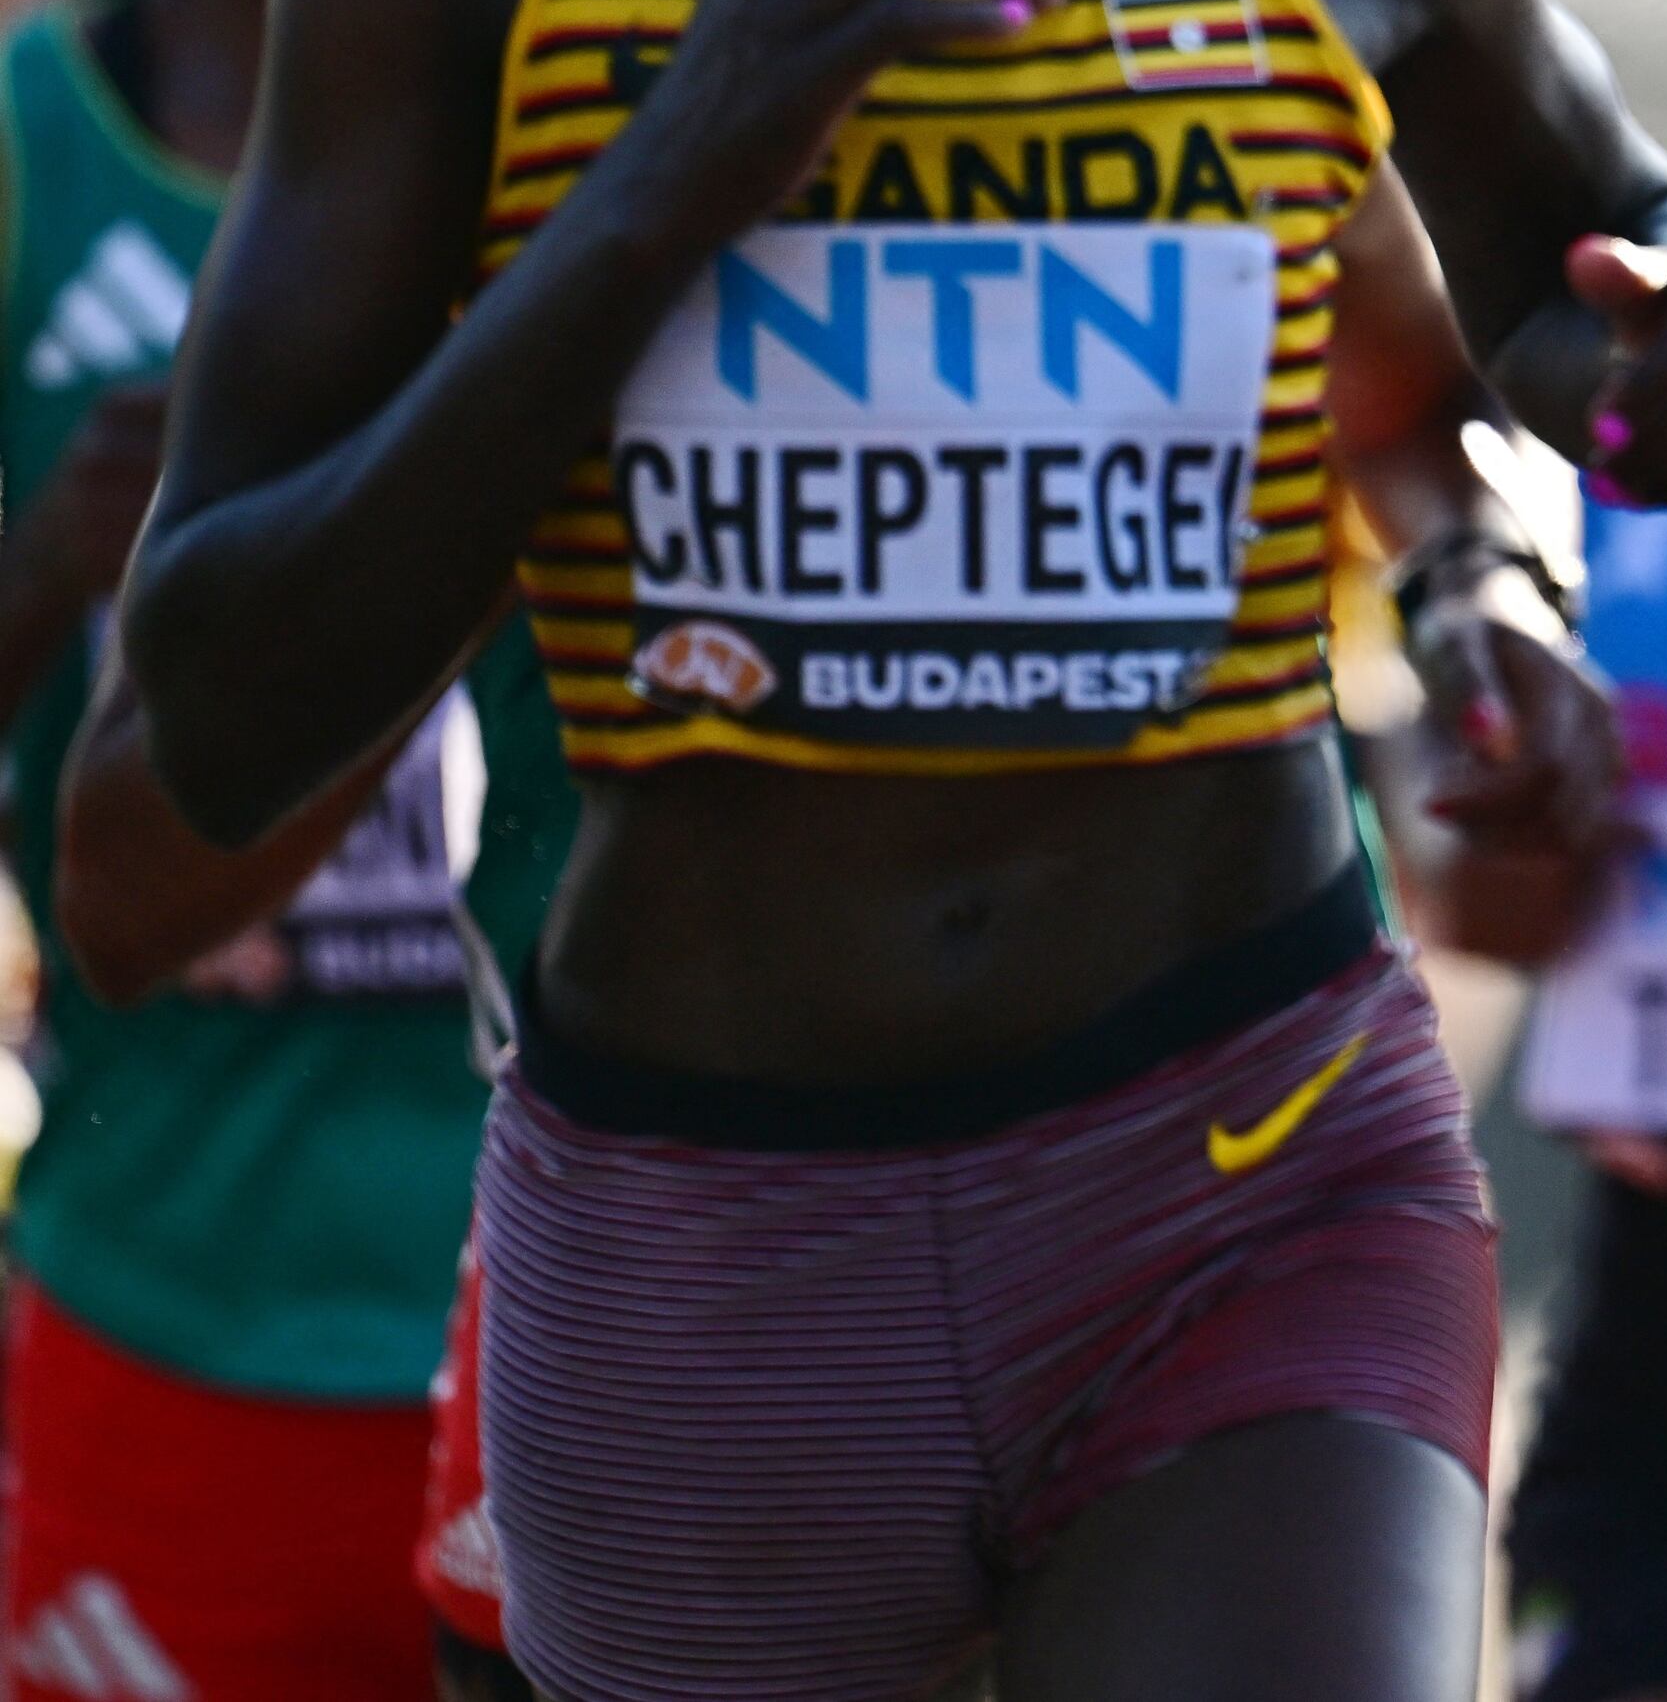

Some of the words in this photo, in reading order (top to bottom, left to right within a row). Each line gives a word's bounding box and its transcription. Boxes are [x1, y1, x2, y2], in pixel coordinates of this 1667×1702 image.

[785, 123, 1250, 220] ANDA
[714, 239, 1183, 405] NTN
[802, 652, 1184, 711] BUDAPEST
